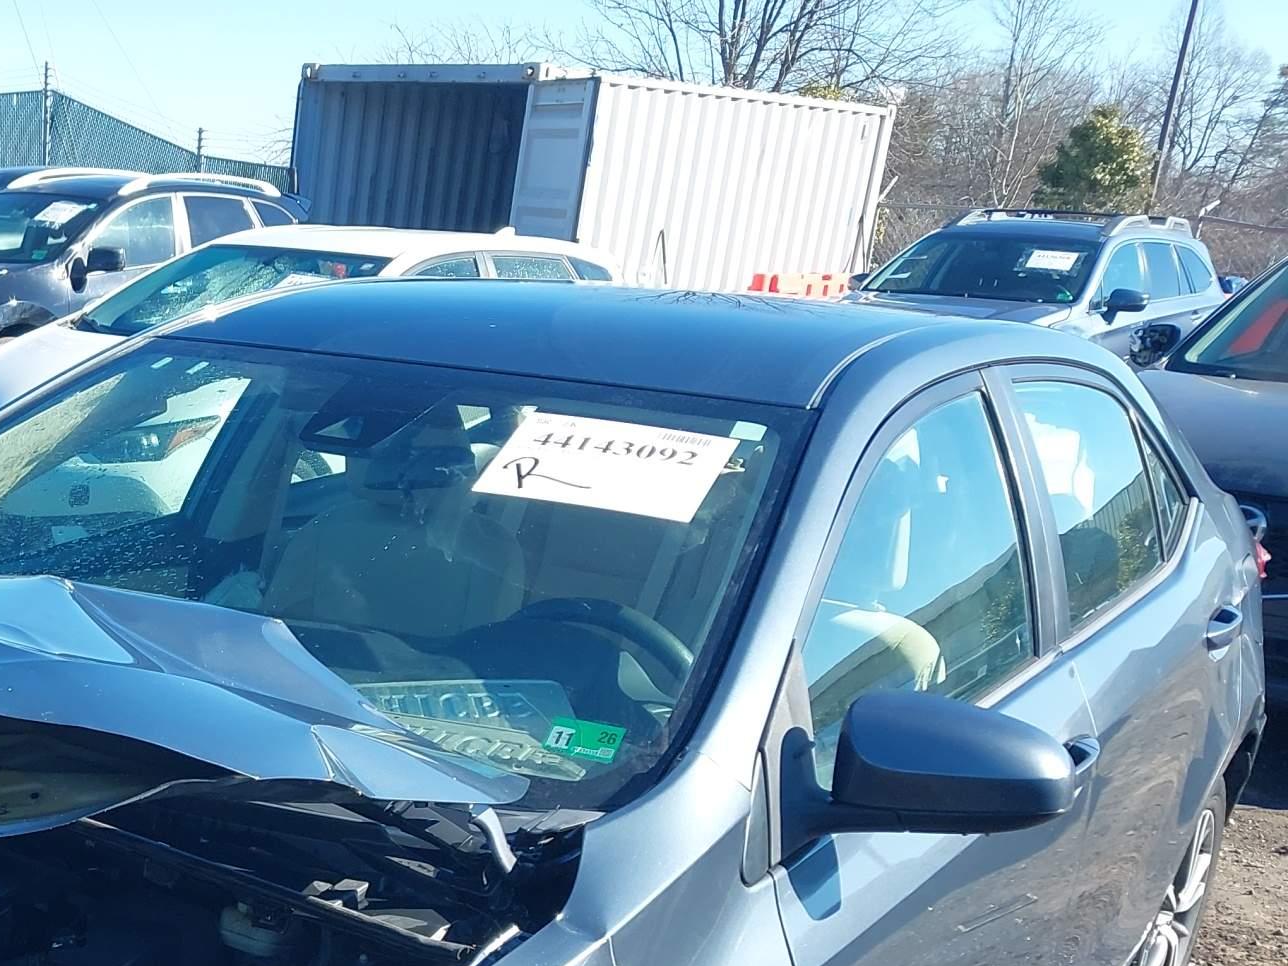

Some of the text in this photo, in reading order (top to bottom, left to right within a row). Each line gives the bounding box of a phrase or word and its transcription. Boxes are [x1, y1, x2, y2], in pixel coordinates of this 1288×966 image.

[533, 432, 699, 466] 44143092
[555, 730, 618, 747] 11 26
